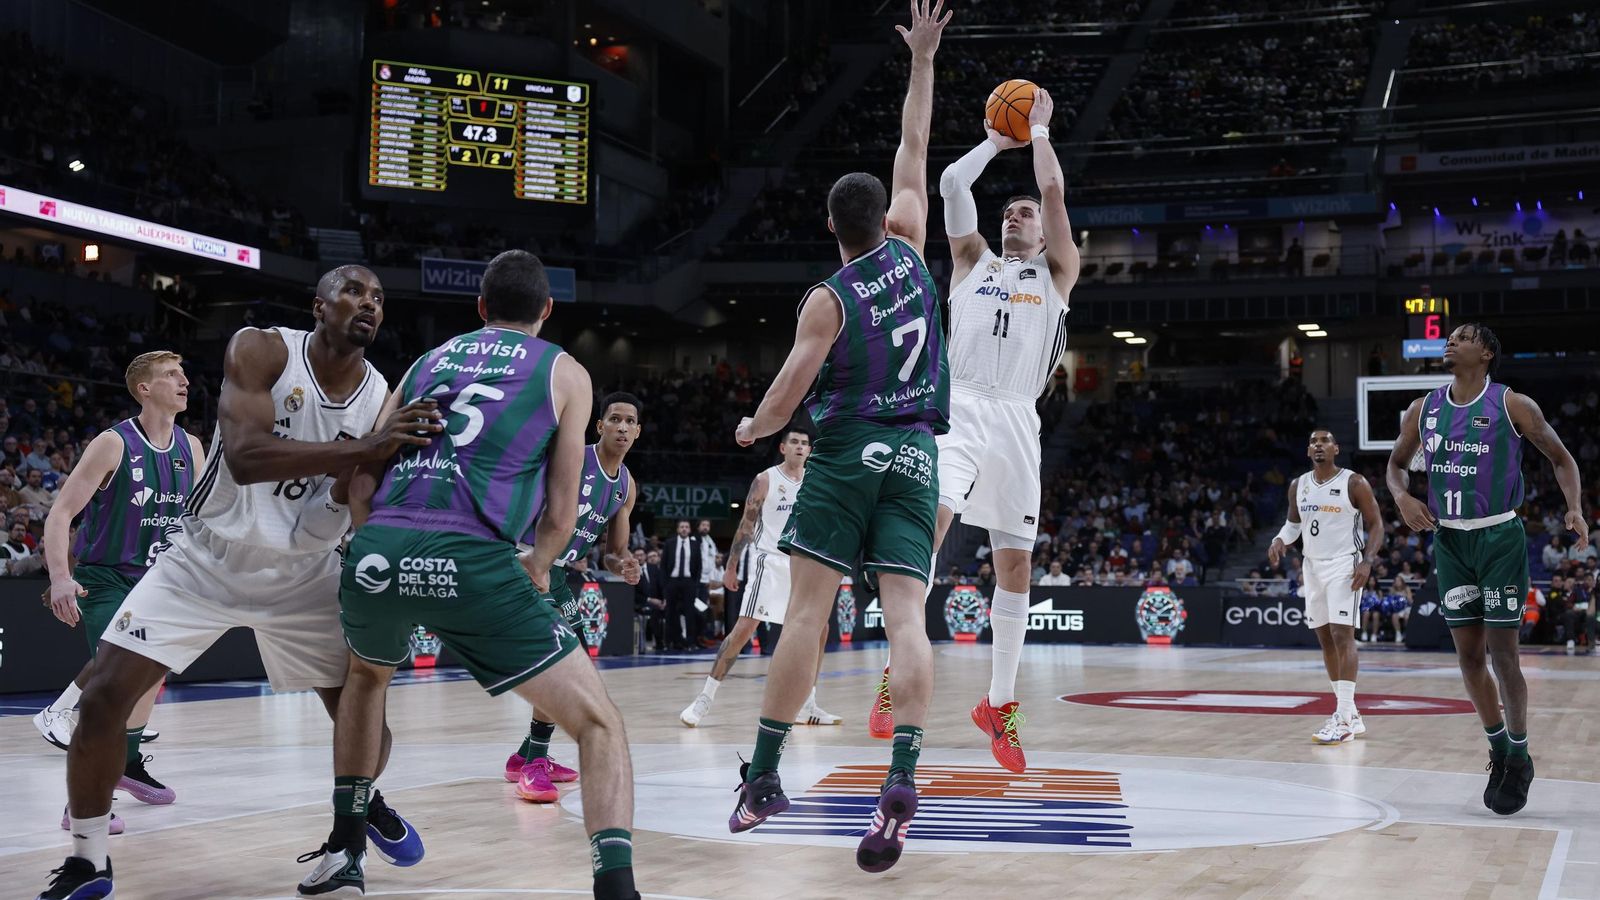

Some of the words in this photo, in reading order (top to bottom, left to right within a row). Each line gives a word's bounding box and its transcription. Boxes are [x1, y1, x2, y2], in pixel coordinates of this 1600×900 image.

[455, 73, 472, 87] 18
[494, 77, 510, 91] 11
[525, 84, 554, 94] UNICAJA
[463, 124, 497, 143] 47.3
[461, 150, 472, 162] 2
[490, 153, 501, 165] 2
[1439, 150, 1525, 166] Comunidad
[1530, 149, 1549, 160] de
[1555, 145, 1600, 158] Madri
[62, 206, 97, 225] NUEVA
[97, 213, 136, 234] TARJETA
[137, 224, 187, 246] ALIEXPRESS
[992, 309, 1010, 338] 11
[1425, 315, 1441, 340] 6
[443, 339, 527, 360] Kravish
[892, 317, 927, 382] 7
[900, 444, 932, 467] COSTA
[1445, 440, 1490, 456] Unicaja
[891, 463, 930, 489] MÁLAGA
[895, 454, 916, 468] DEL
[918, 462, 932, 480] SOL
[642, 486, 725, 504] SALIDA
[1444, 490, 1462, 516] 11
[662, 504, 700, 517] EXIT
[1310, 519, 1320, 537] 8
[399, 557, 458, 573] COSTA
[399, 573, 426, 585] DEL
[428, 574, 458, 586] SOL
[399, 584, 458, 598] MÁLAGA
